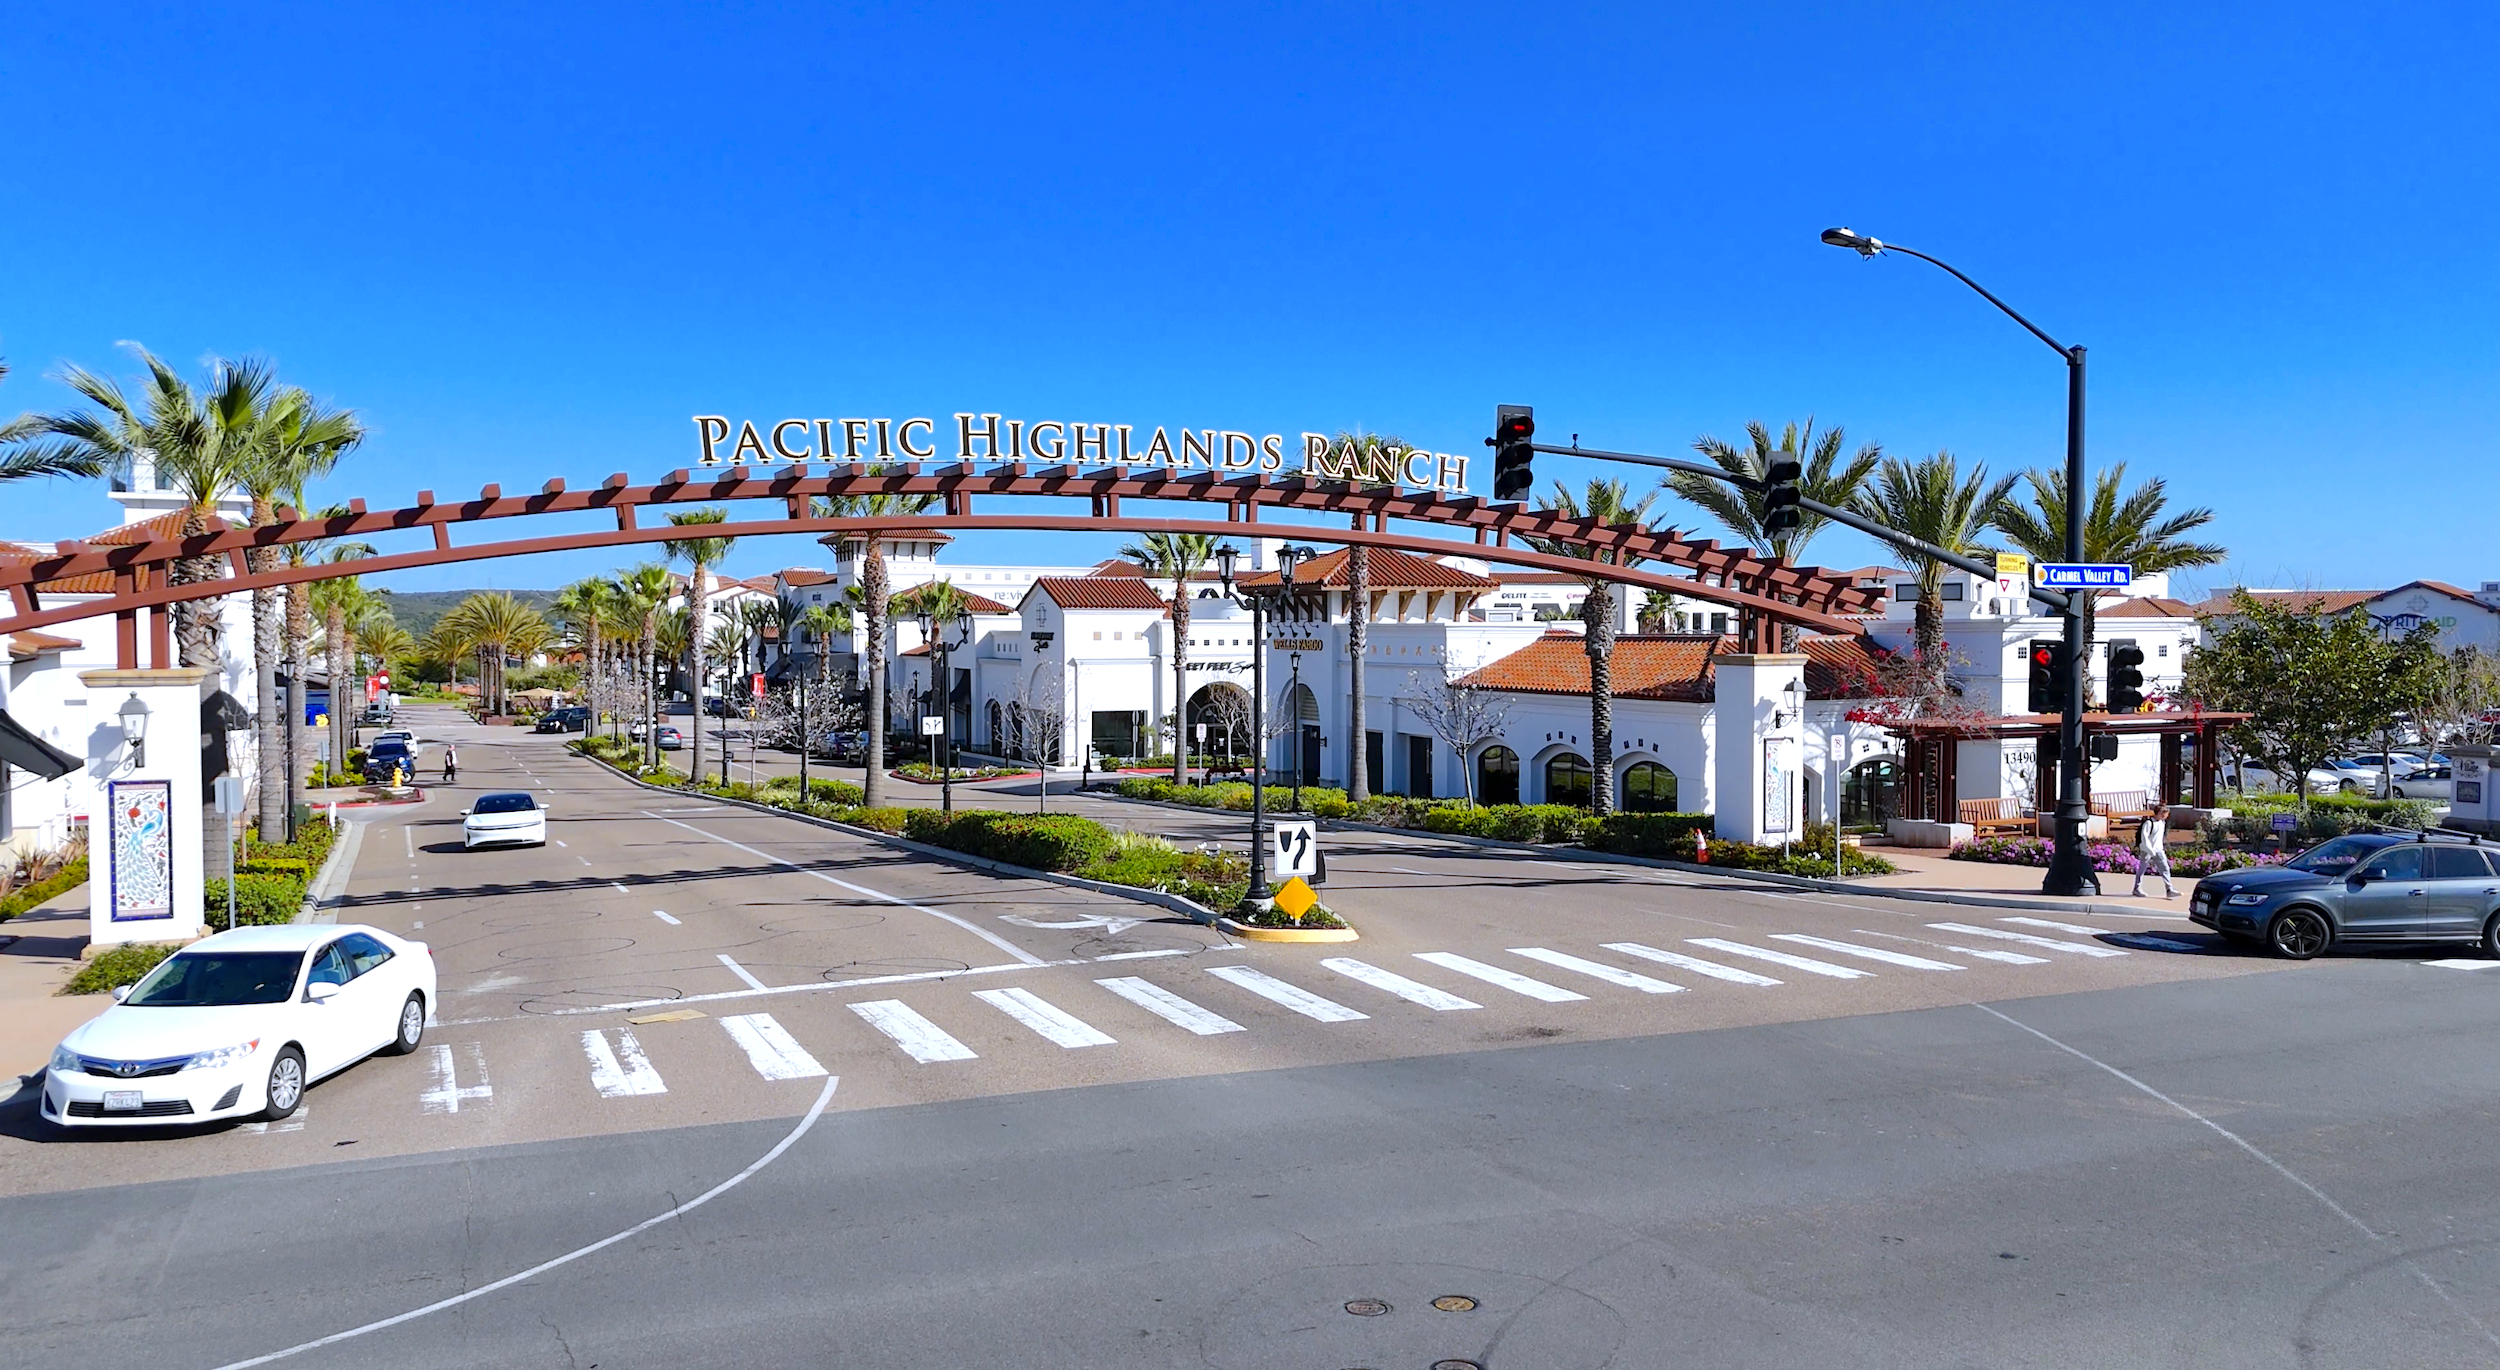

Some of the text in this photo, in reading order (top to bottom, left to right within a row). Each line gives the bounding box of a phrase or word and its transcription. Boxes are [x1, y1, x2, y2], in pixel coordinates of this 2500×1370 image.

[694, 413, 1469, 491] PACIFIC HIGHLANDS RANCH
[2050, 569, 2081, 583] CARMEL
[2084, 569, 2112, 583] VALLEY
[1273, 638, 1324, 651] WELLS FARGO
[2004, 752, 2036, 765] 13490
